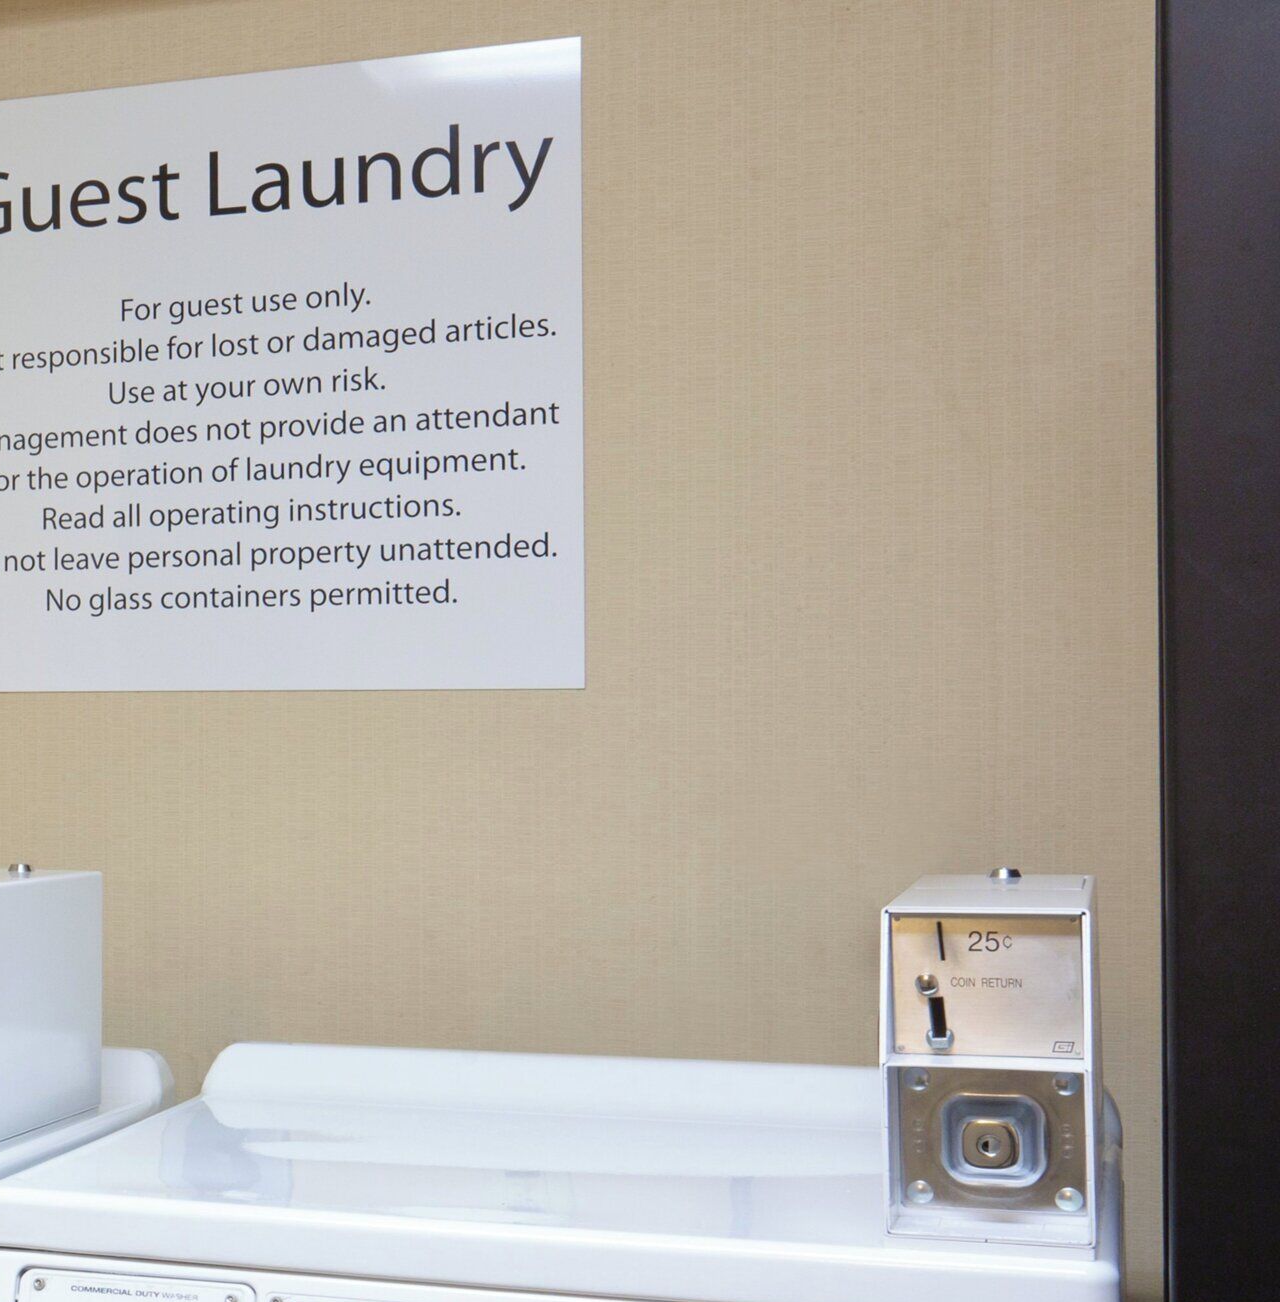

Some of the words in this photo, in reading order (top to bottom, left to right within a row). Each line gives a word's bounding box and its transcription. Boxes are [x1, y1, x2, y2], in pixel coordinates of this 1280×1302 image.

[208, 123, 554, 217] Laundry
[121, 298, 162, 322] For
[168, 293, 243, 326] guest
[251, 292, 298, 313] use
[305, 281, 371, 314] only.
[12, 337, 160, 374] responsible
[166, 335, 204, 361] for
[211, 332, 259, 358] lost
[266, 334, 296, 354] or
[302, 318, 436, 354] damaged
[445, 312, 557, 343] articles.
[109, 381, 155, 405] Use
[162, 380, 188, 402] at
[195, 379, 256, 407] your
[263, 375, 322, 397] own
[332, 365, 386, 393] risk.
[135, 419, 198, 445] does
[206, 418, 252, 442] not
[260, 409, 365, 446] provide
[373, 413, 406, 434] an
[415, 400, 560, 431] attendant
[26, 466, 69, 491] the
[76, 461, 203, 494] operation
[211, 456, 240, 483] of
[246, 453, 351, 485] laundry
[359, 448, 526, 482] equipment.
[42, 504, 104, 531] Read
[112, 502, 141, 528] all
[149, 500, 279, 533] operating
[289, 494, 461, 522] instructions.
[4, 551, 46, 572] not
[54, 546, 120, 571] leave
[128, 541, 241, 575] personal
[251, 541, 371, 572] property
[380, 531, 557, 562] unattended.
[46, 588, 82, 612] No
[89, 586, 153, 618] glass
[160, 584, 301, 610] containers
[310, 578, 458, 613] permitted.
[950, 976, 976, 988] COIN
[981, 977, 1023, 988] RETURN
[70, 1284, 133, 1296] COMMERCIAL
[135, 1289, 160, 1298] DUTY
[161, 1292, 199, 1301] WASHER
